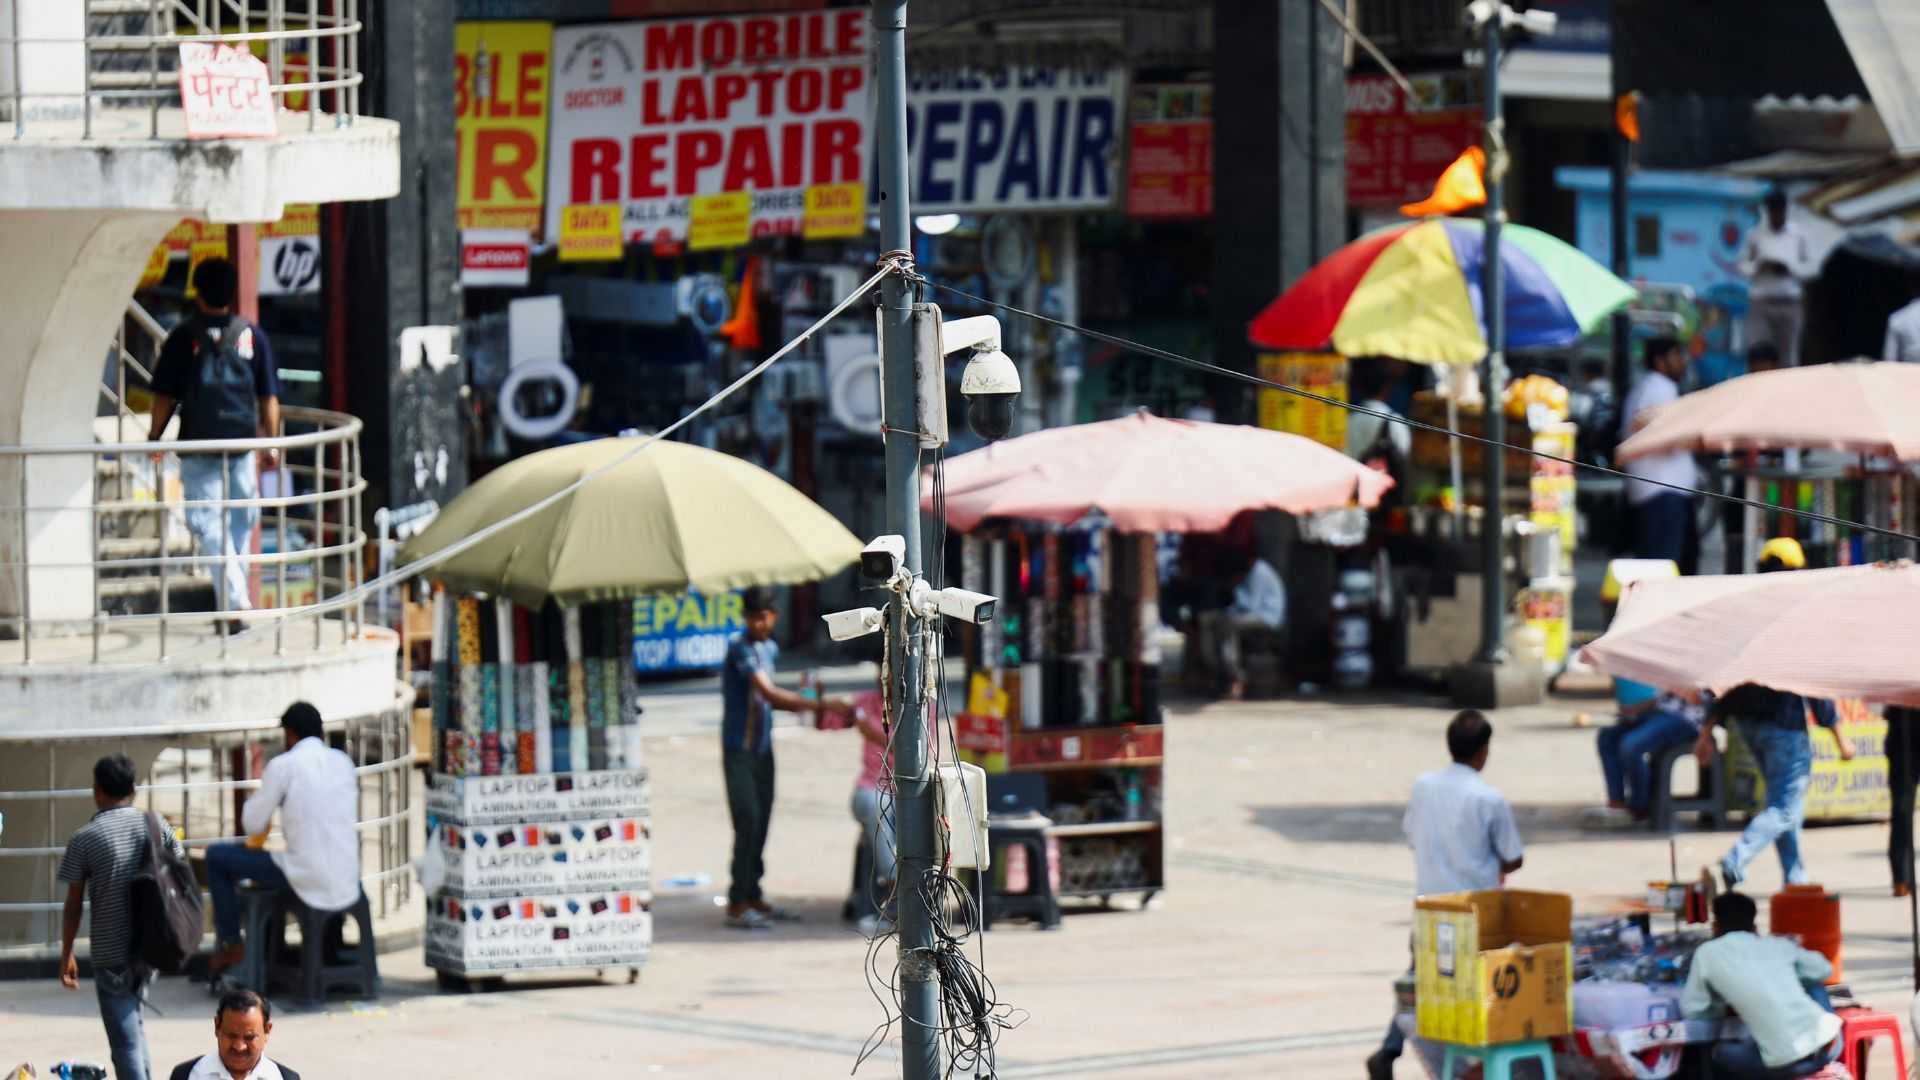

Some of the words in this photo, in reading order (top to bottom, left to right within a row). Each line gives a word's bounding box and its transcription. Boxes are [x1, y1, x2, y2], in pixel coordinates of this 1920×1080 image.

[644, 11, 864, 72] MOBILE
[564, 88, 625, 111] DOCTOR
[642, 66, 864, 126] LAPTOP
[571, 119, 864, 205] REPAIR
[275, 239, 320, 289] hp
[465, 248, 521, 264] Lenovo
[479, 777, 549, 796] LAPTOP
[577, 772, 648, 791] LAPTOP
[472, 799, 558, 813] LAMINATION
[476, 852, 545, 870] LAPTOP
[574, 847, 641, 864] LAPTOP
[470, 873, 554, 888] LAMINATION
[476, 924, 545, 940] LAPTOP
[573, 920, 641, 936] LAPTOP
[468, 944, 554, 959] LAMINATION
